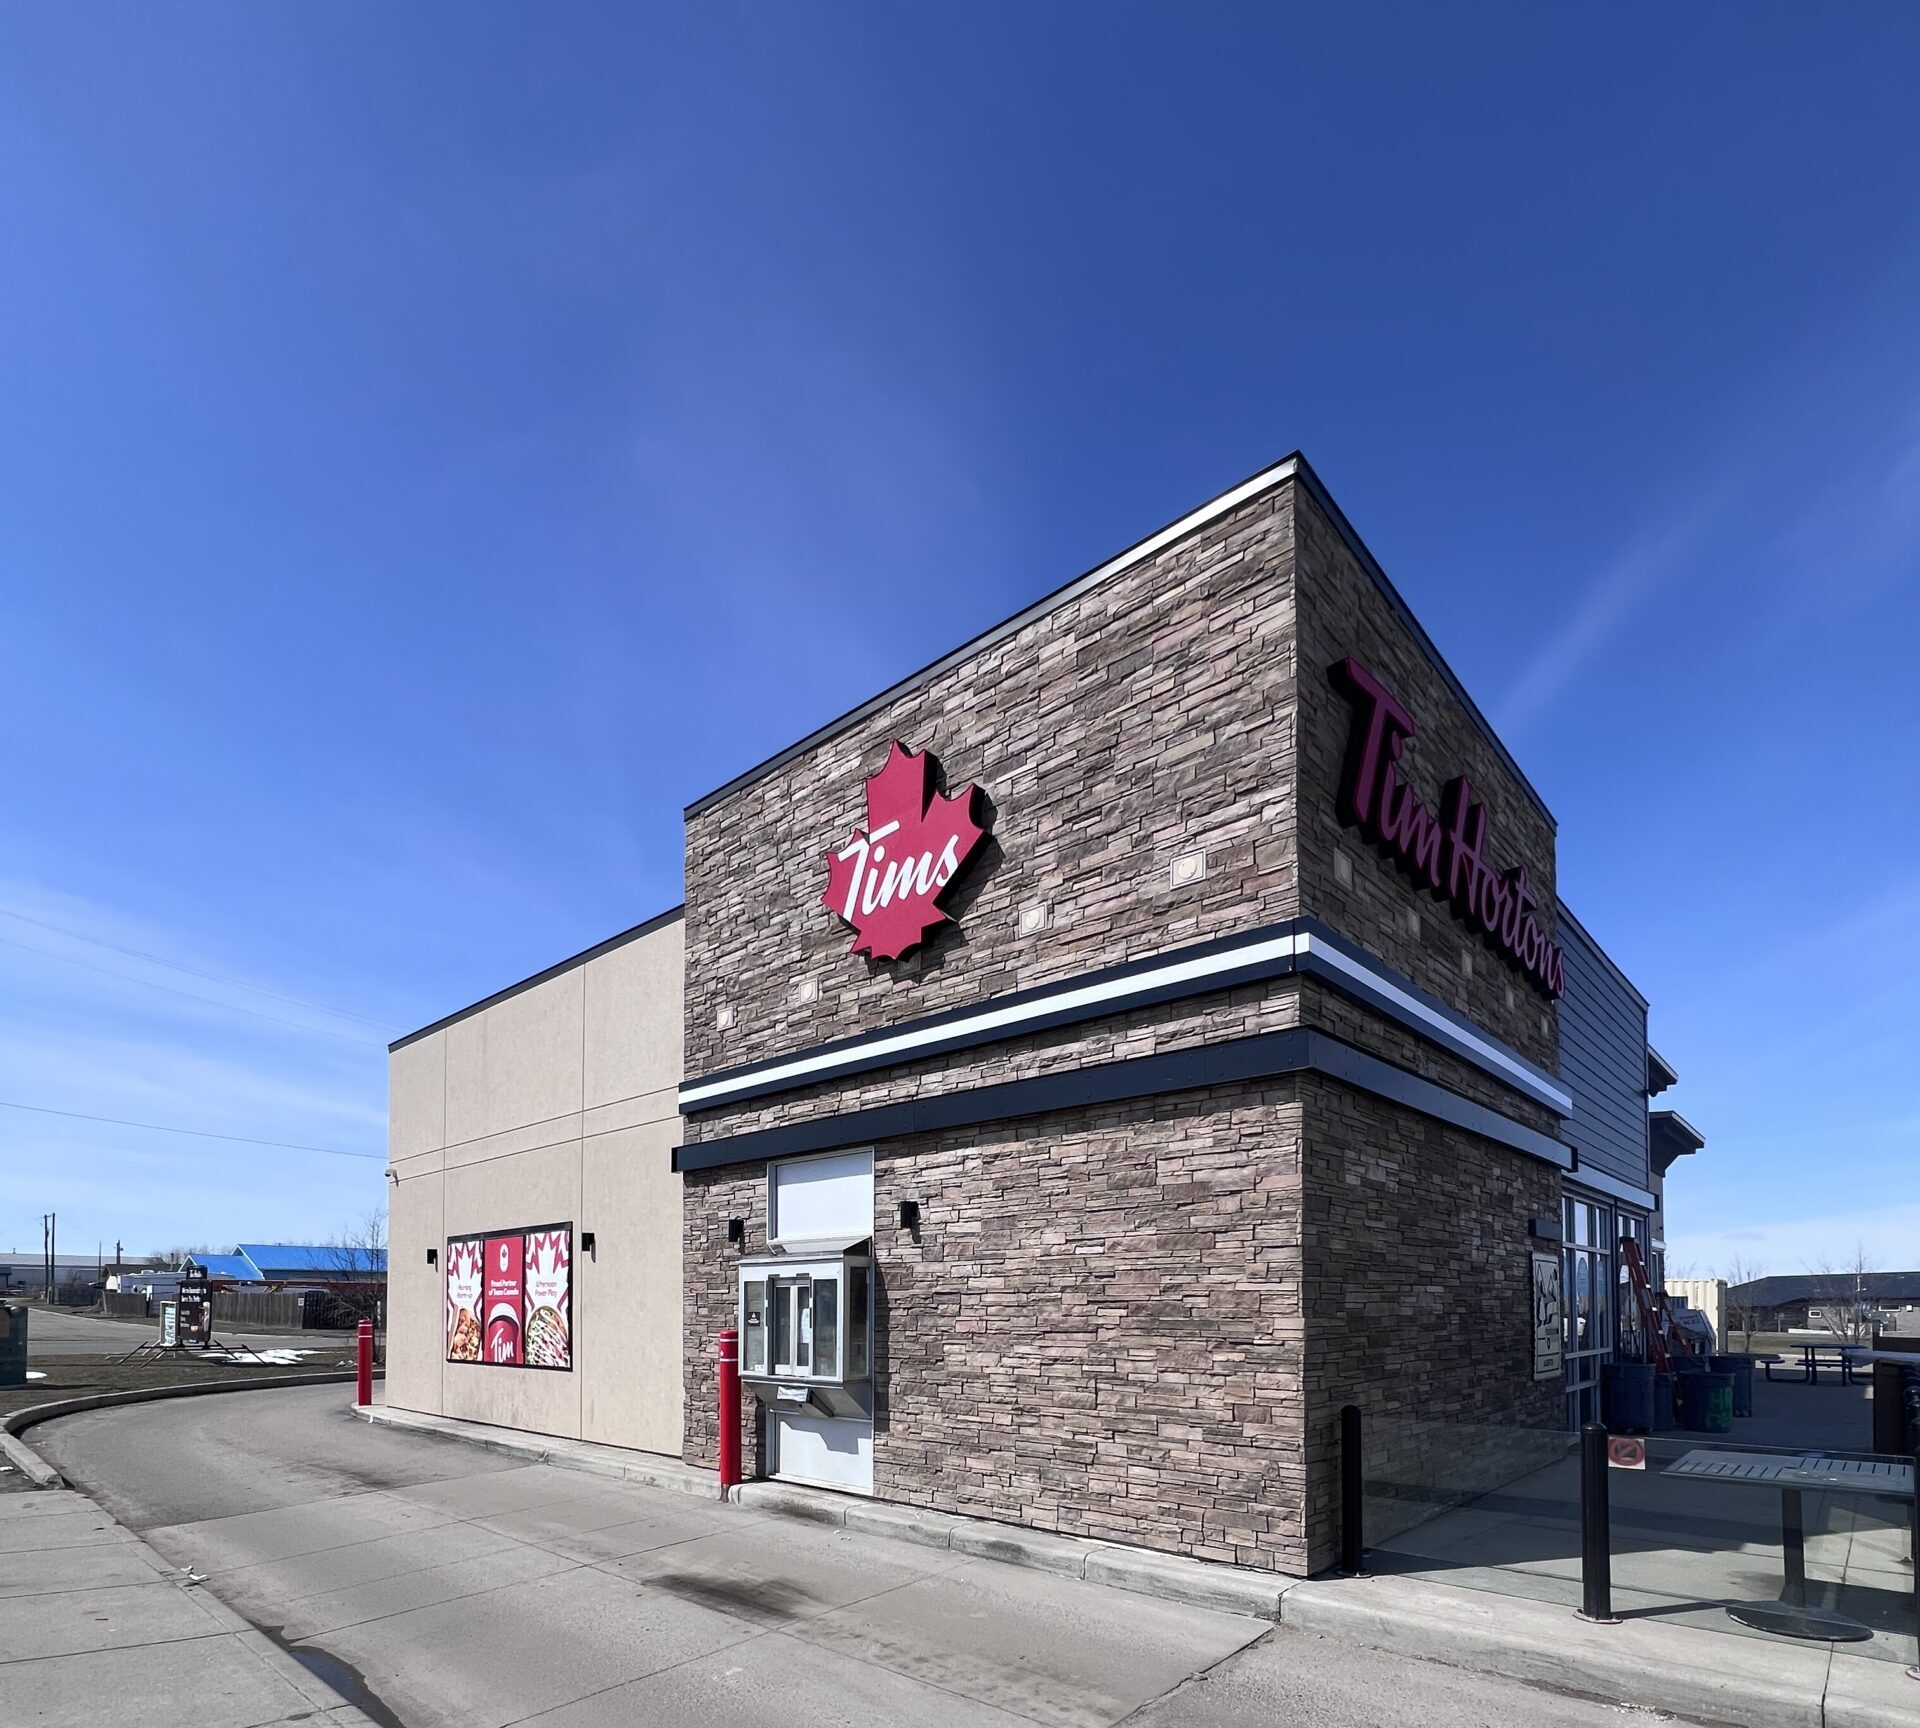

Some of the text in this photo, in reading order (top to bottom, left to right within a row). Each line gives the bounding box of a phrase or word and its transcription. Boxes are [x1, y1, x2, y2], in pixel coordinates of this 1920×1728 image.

[837, 819, 960, 923] Tims
[1343, 654, 1566, 999] Tim Hortons
[490, 1327, 515, 1363] Tim
